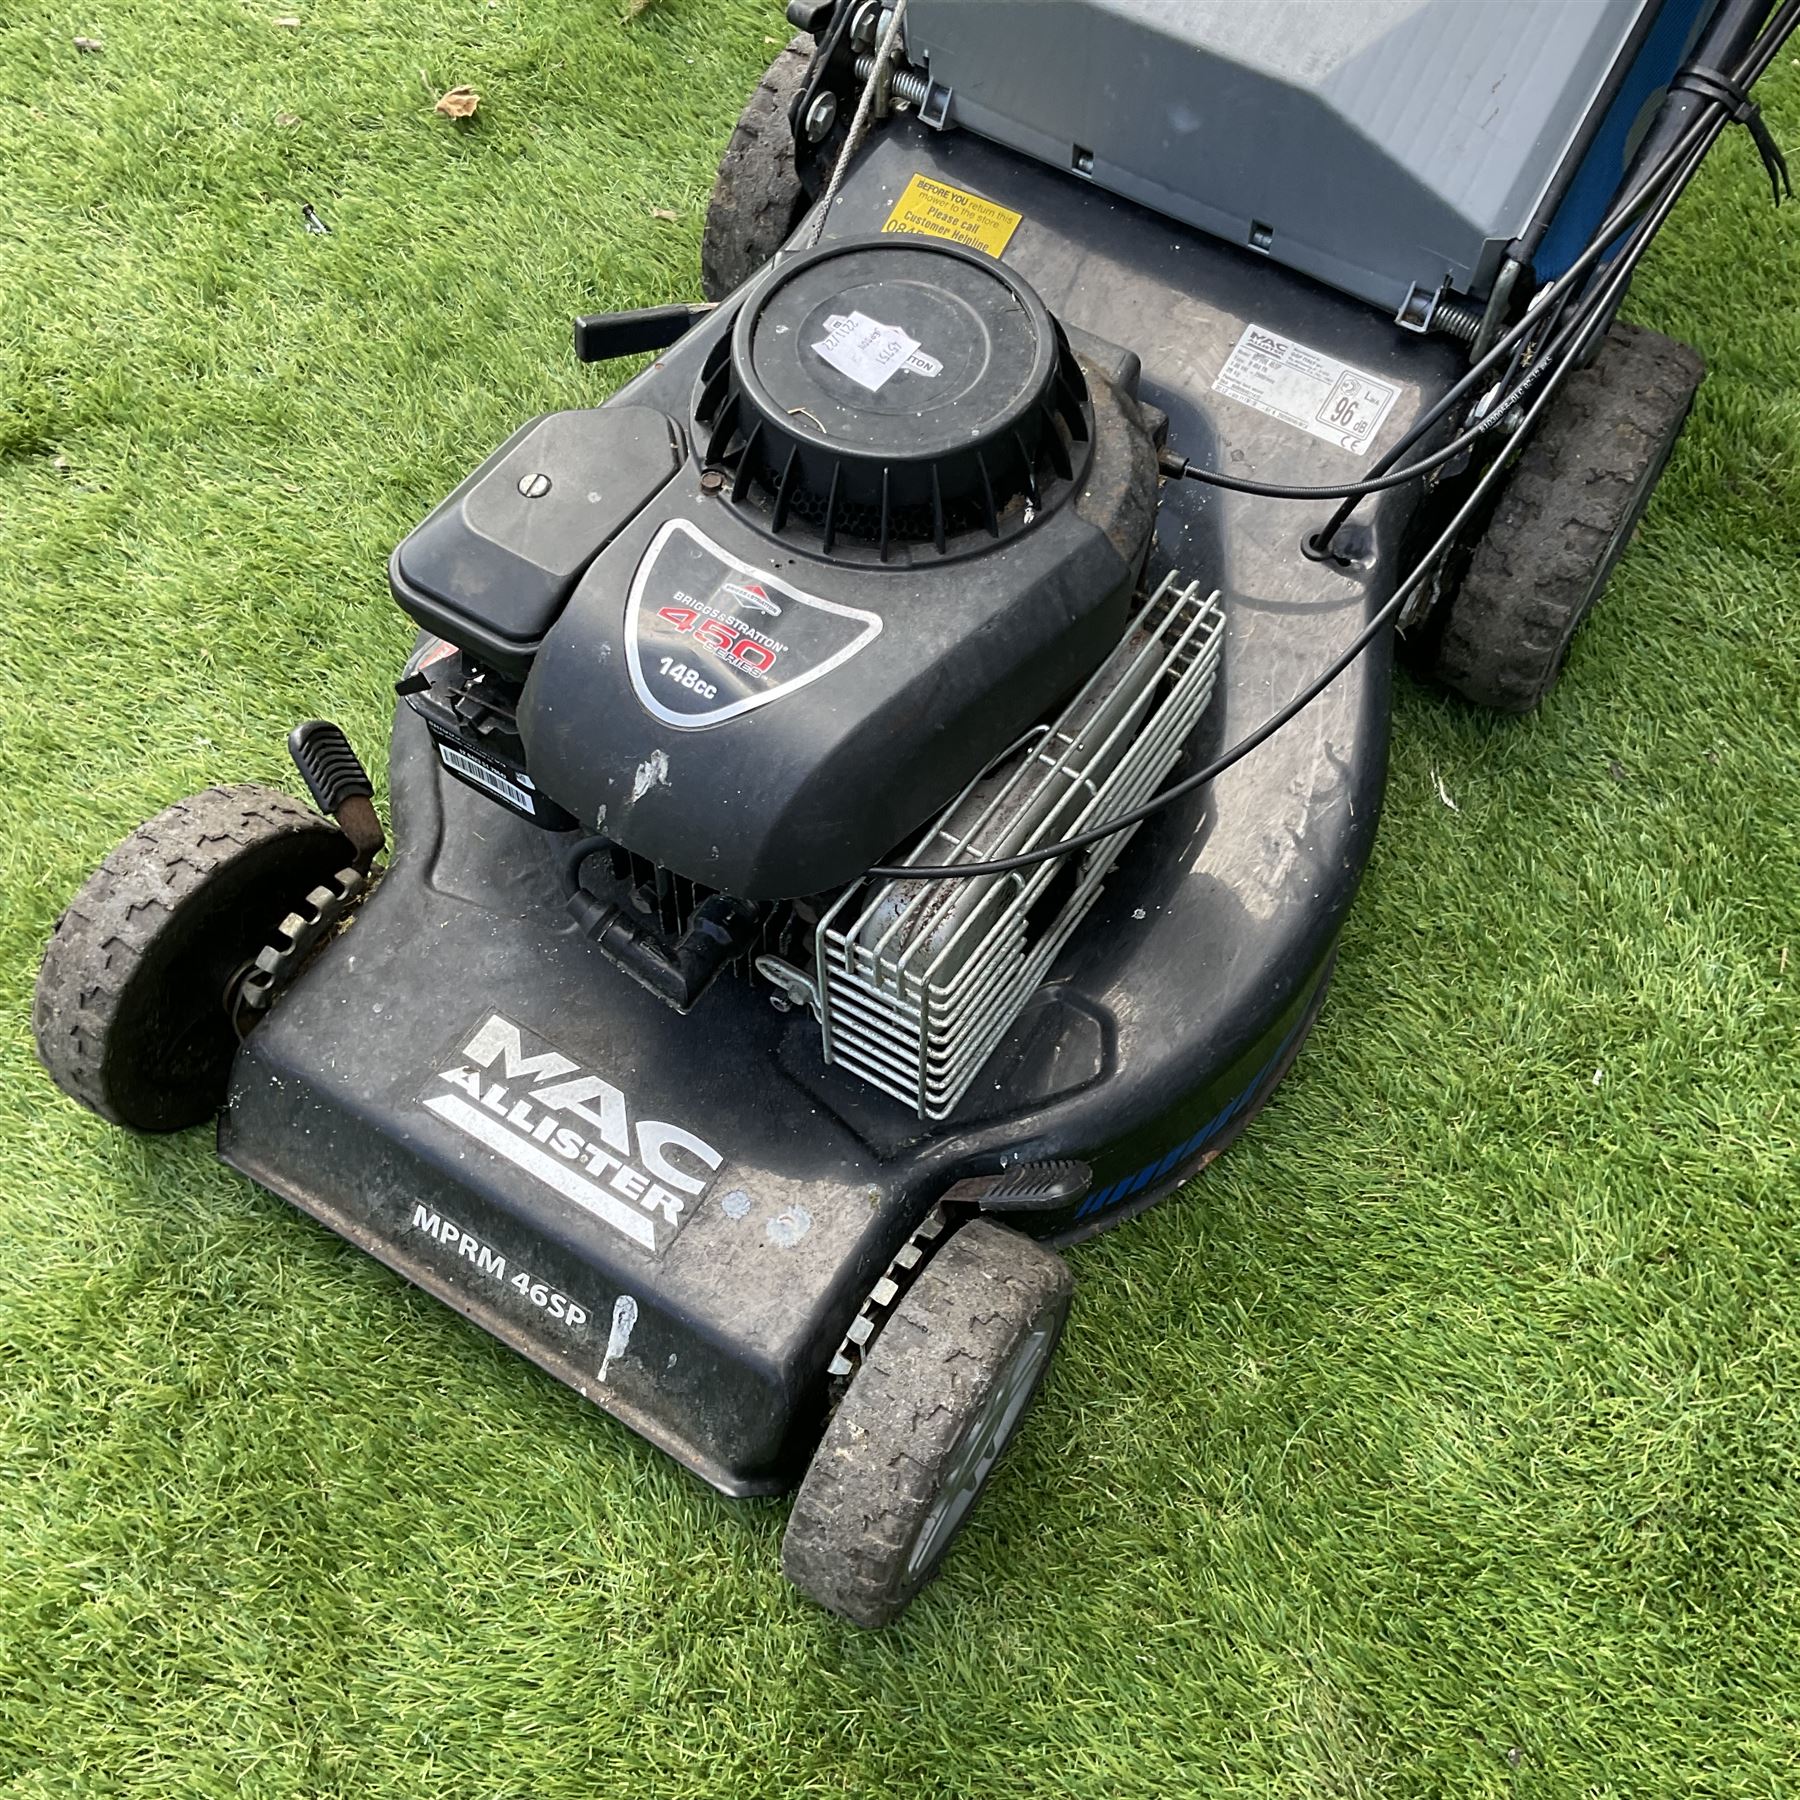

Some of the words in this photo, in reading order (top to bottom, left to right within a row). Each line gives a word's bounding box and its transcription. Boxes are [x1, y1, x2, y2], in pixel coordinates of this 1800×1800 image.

[917, 180, 949, 198] BEFORE
[951, 192, 969, 206] YOU
[968, 202, 995, 216] return
[996, 212, 1013, 225] this
[919, 191, 949, 207] mower
[950, 203, 960, 213] to
[961, 208, 976, 218] the
[928, 206, 961, 225] Please
[961, 218, 981, 234] call
[904, 210, 951, 235] Customer
[951, 230, 990, 251] Helpline
[1250, 331, 1289, 352] MAC
[1330, 397, 1359, 426] 96
[1353, 420, 1368, 433] dB
[657, 606, 777, 675] 450
[703, 641, 763, 680] SERIES
[660, 656, 718, 700] 148cc
[462, 1014, 724, 1196] MAC
[437, 1065, 685, 1228] ALLISTER
[412, 1204, 507, 1281] MPRM
[511, 1271, 587, 1328] 46SP
